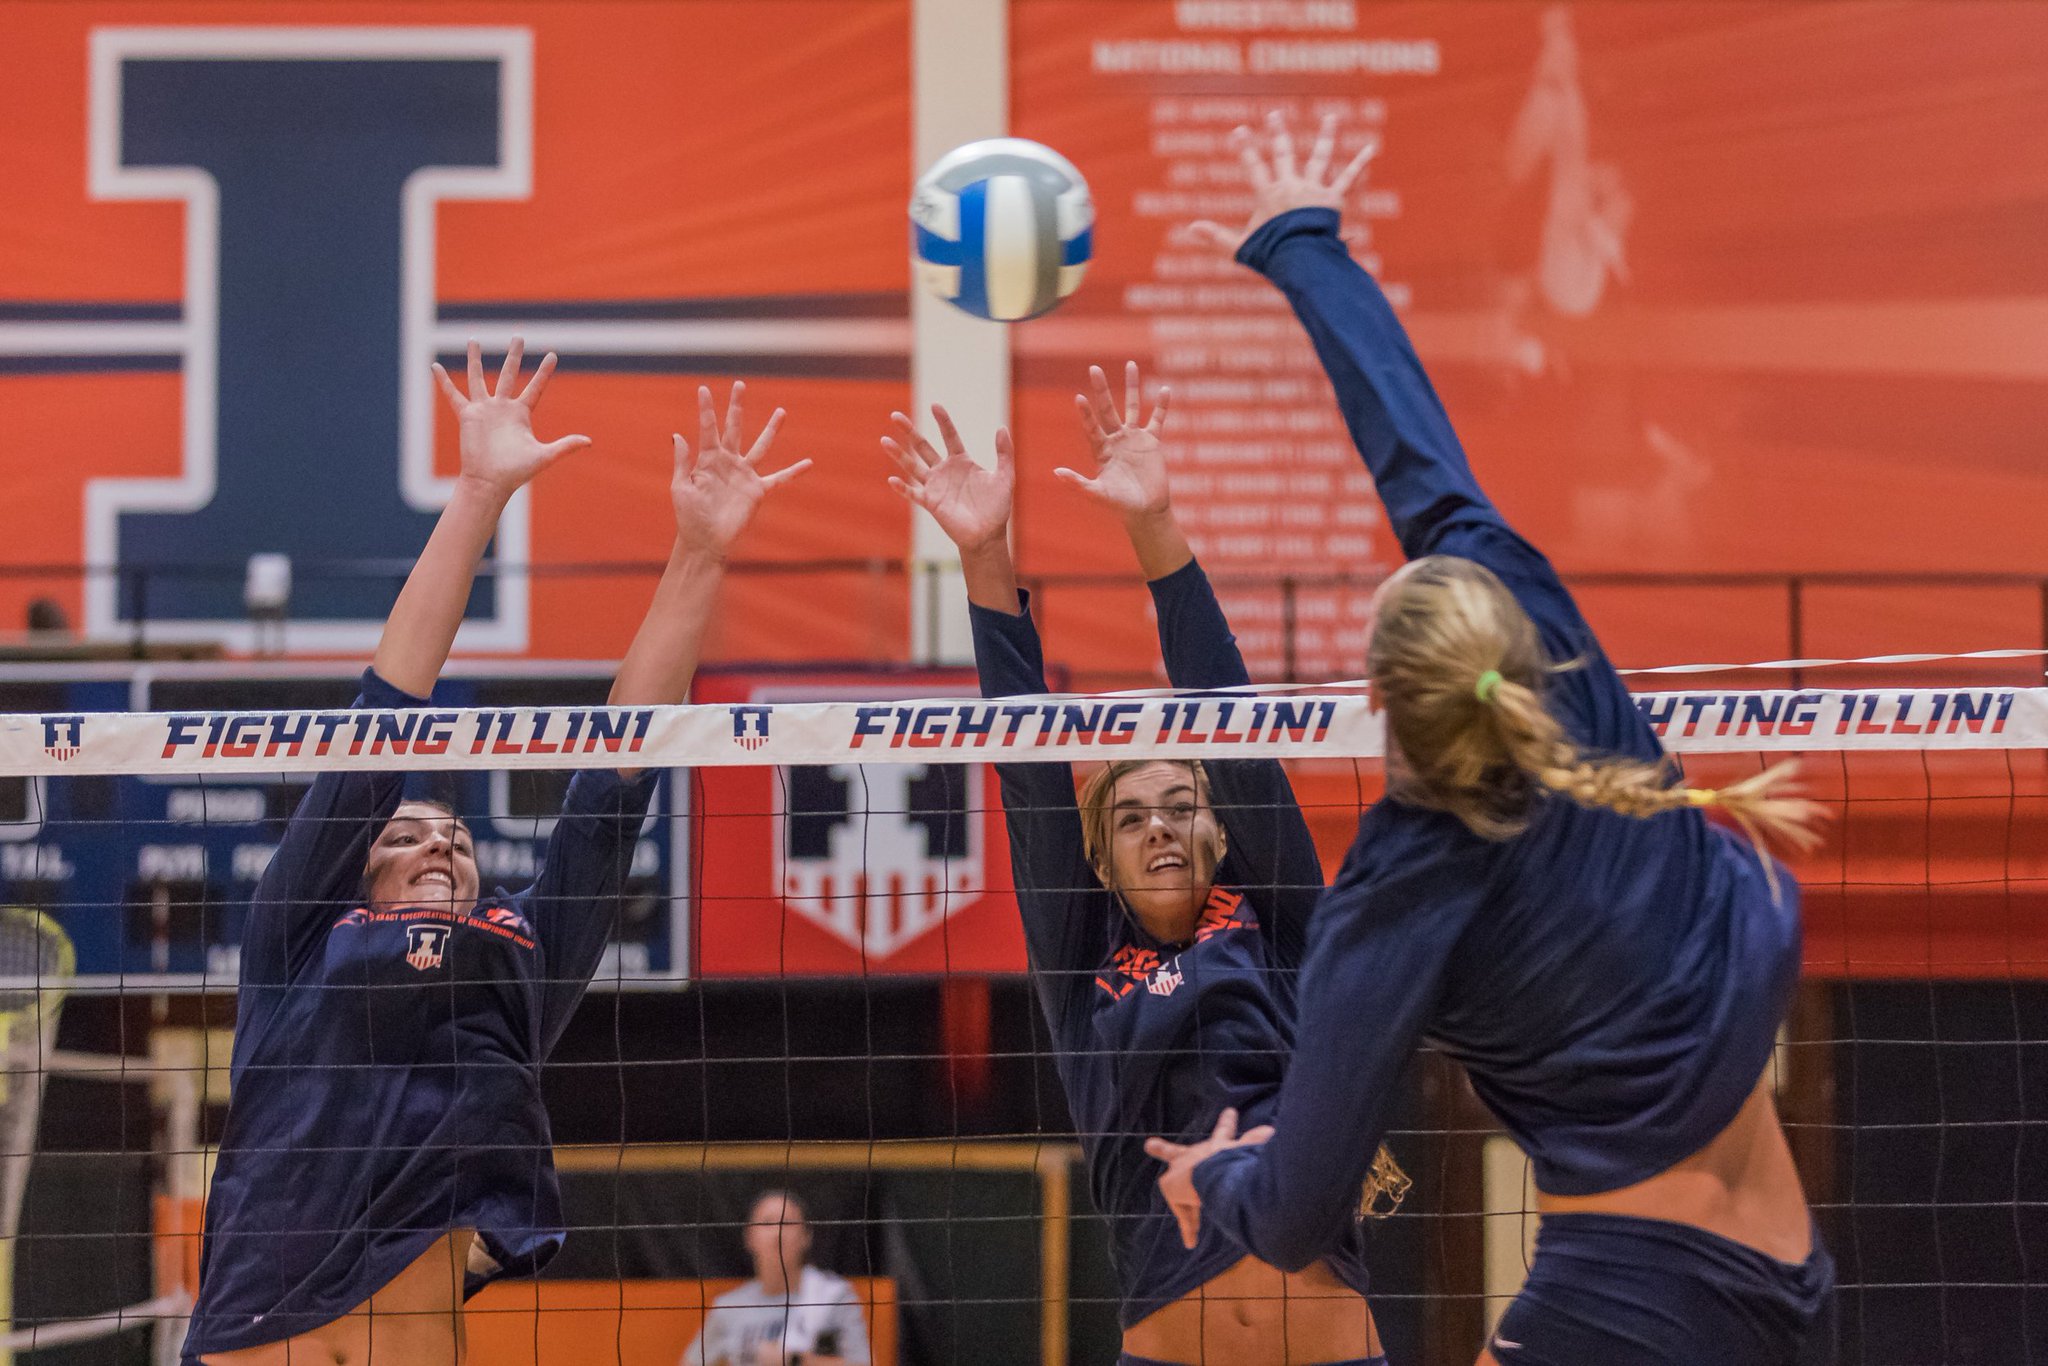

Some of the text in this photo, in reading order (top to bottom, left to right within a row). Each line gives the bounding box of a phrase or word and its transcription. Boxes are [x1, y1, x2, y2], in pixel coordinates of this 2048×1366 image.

[1092, 41, 1440, 74] NATIONAL CHAMPIONS
[161, 711, 654, 758] FIGHTING ILLINI
[850, 702, 1337, 749] FIGHTING ILLINI
[1836, 693, 2015, 735] ILLINI
